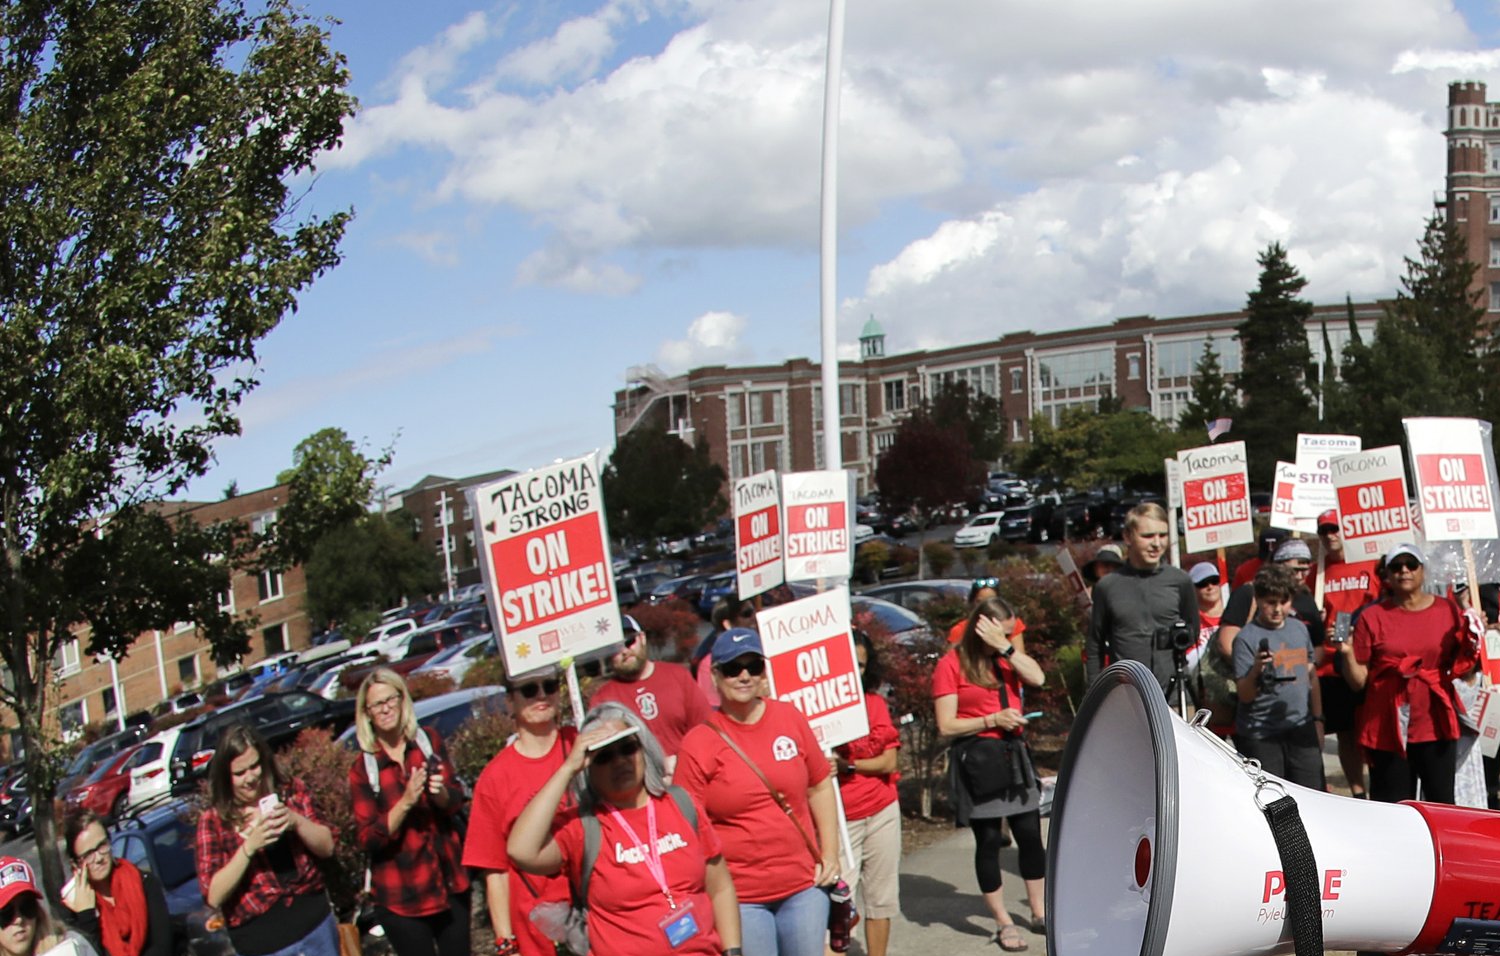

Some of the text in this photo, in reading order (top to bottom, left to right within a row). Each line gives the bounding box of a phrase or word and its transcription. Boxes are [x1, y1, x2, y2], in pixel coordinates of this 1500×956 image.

[1303, 437, 1356, 446] Tacoma
[1182, 452, 1246, 473] Tacoma
[1317, 459, 1328, 470] O
[1331, 455, 1388, 477] Tacoma
[1438, 458, 1467, 482] ON
[491, 462, 596, 515] TACOMA
[737, 479, 775, 507] TACOMA
[788, 489, 835, 500] TACOMA
[1203, 479, 1227, 502] ON
[1358, 485, 1385, 510] ON
[1423, 484, 1490, 510] STRIKE!
[509, 492, 589, 533] STRONG
[750, 512, 769, 539] ON
[805, 506, 829, 529] ON
[1187, 498, 1248, 528] STRIKE!
[1342, 507, 1408, 538] STRIKE!
[526, 529, 570, 575] ON
[740, 533, 780, 571] STRIKE!
[788, 529, 846, 555] STRIKE!
[502, 562, 609, 628] STRIKE!
[765, 604, 837, 641] TACOMA
[796, 645, 830, 682] ON
[1262, 870, 1342, 903] PE
